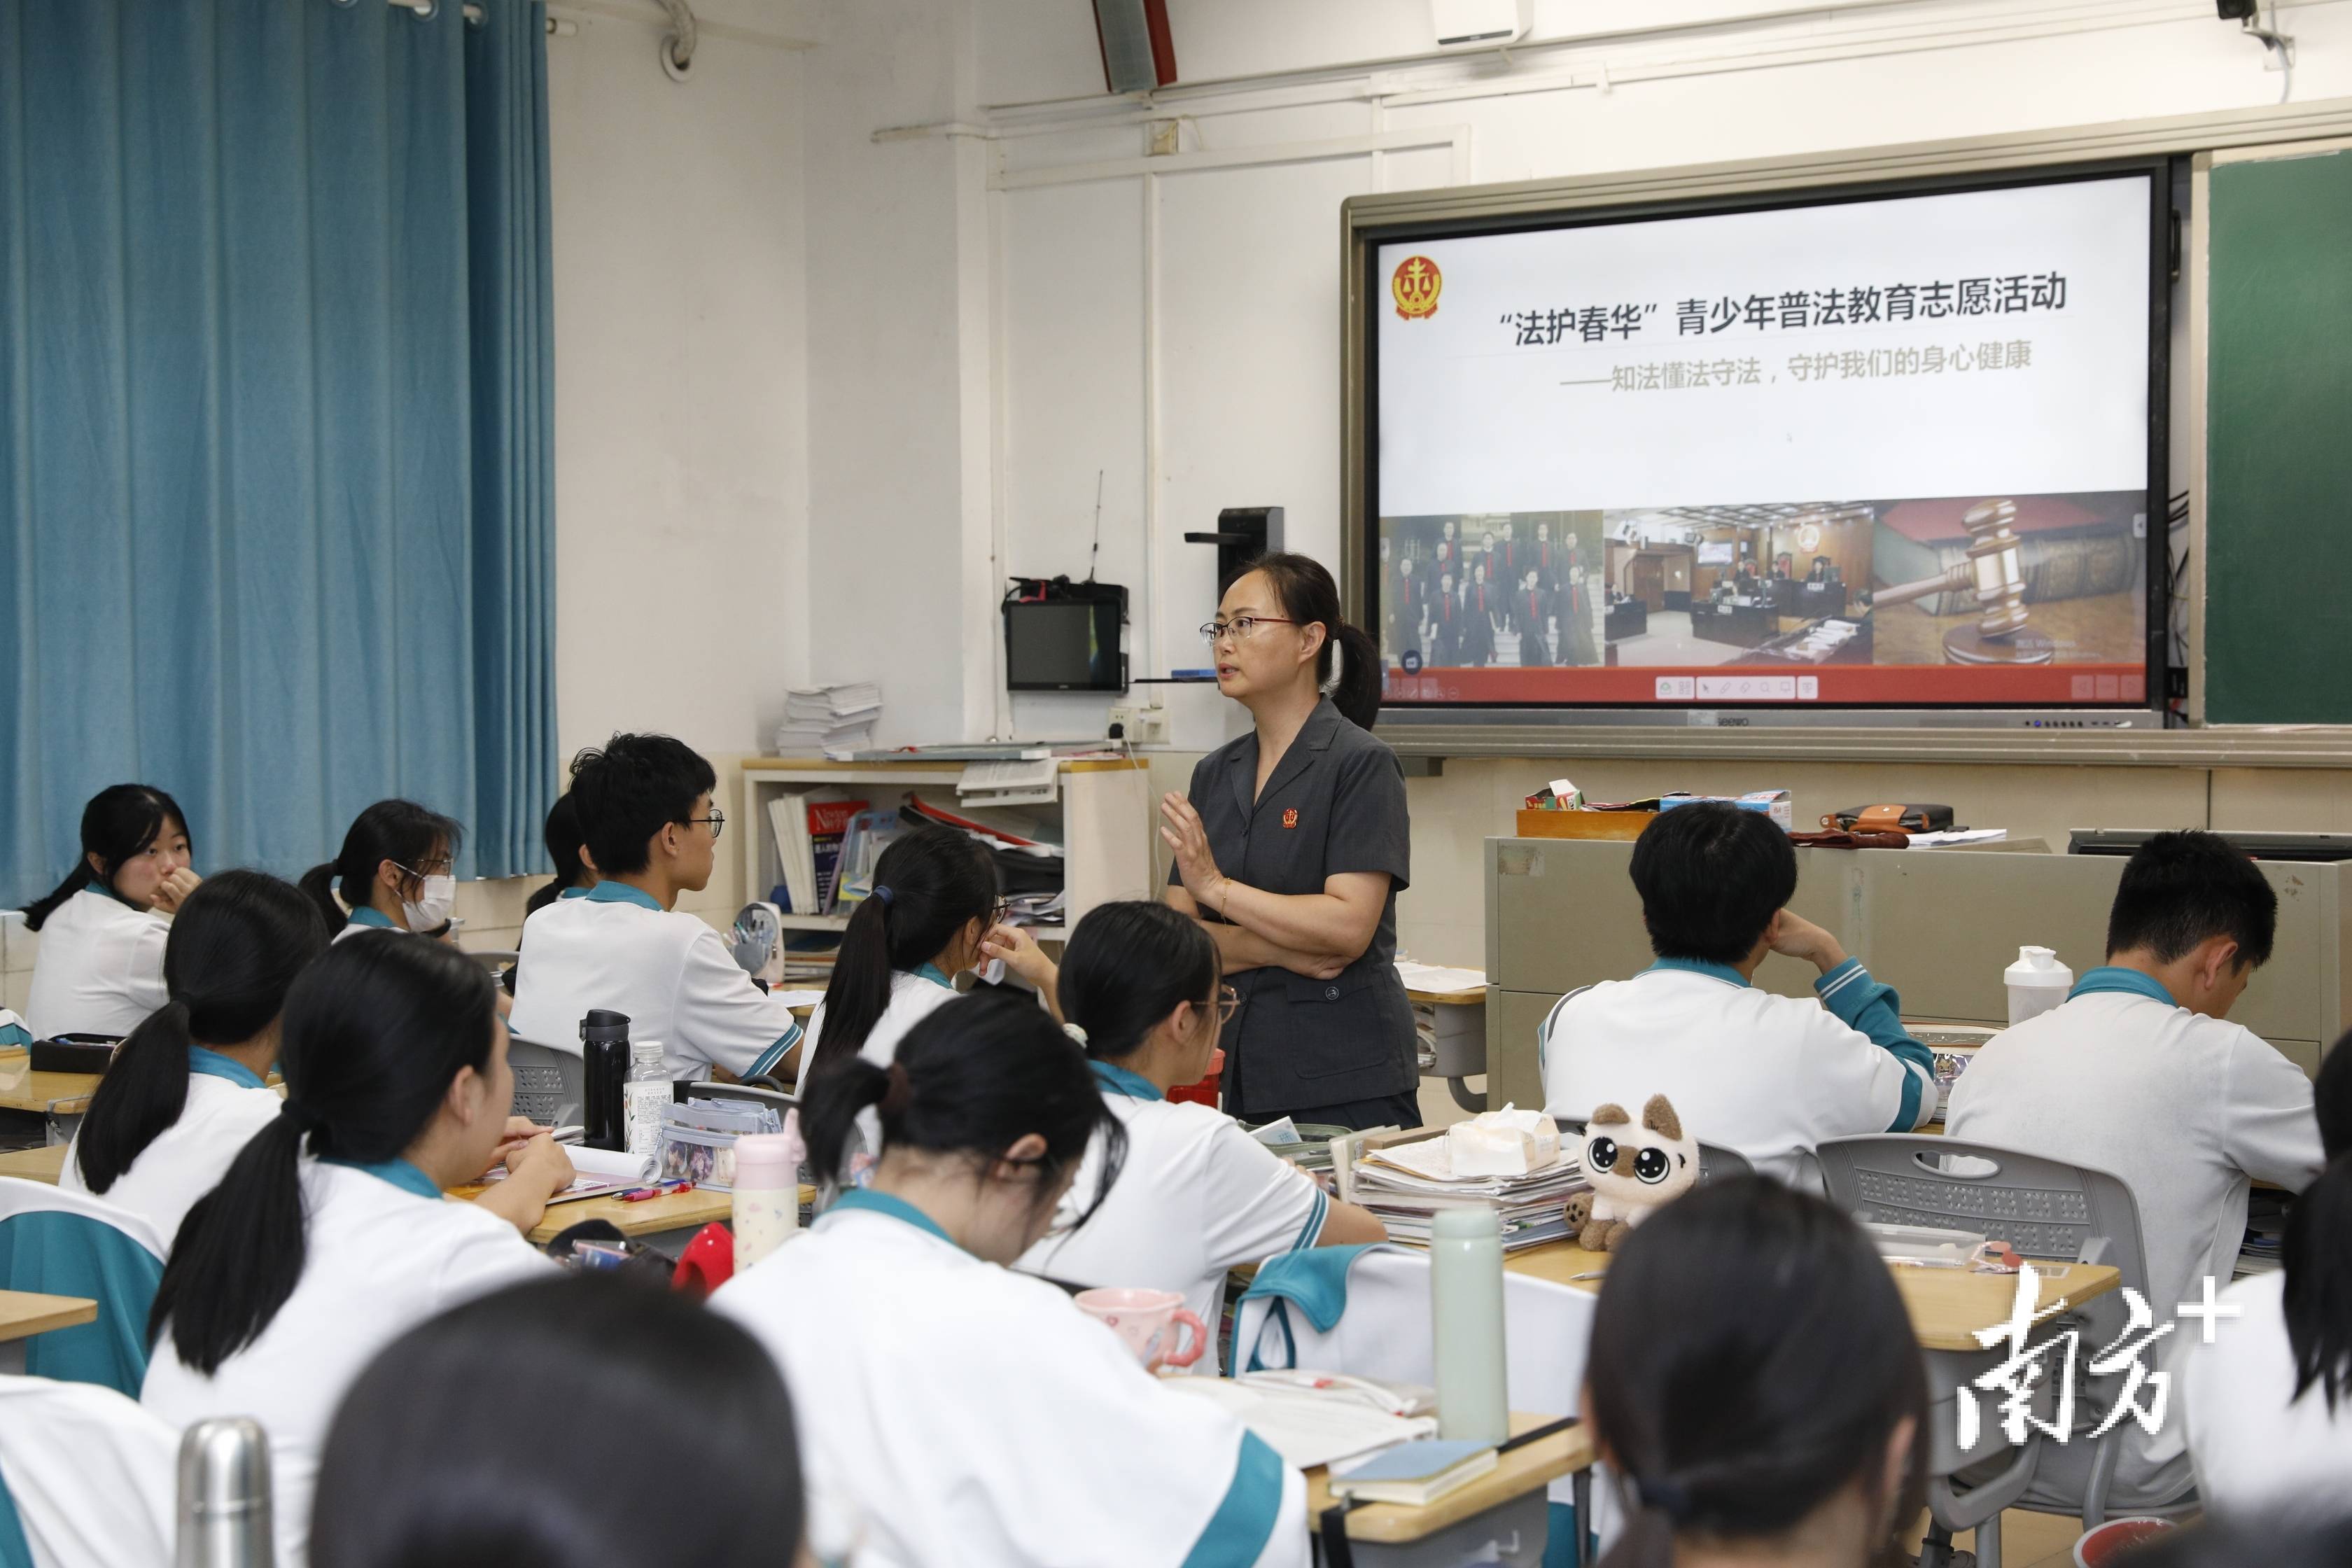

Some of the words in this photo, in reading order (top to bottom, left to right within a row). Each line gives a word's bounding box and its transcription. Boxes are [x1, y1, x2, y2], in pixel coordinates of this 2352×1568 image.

[1499, 271, 2067, 346] “法护春华”青少年普法教育志愿活动
